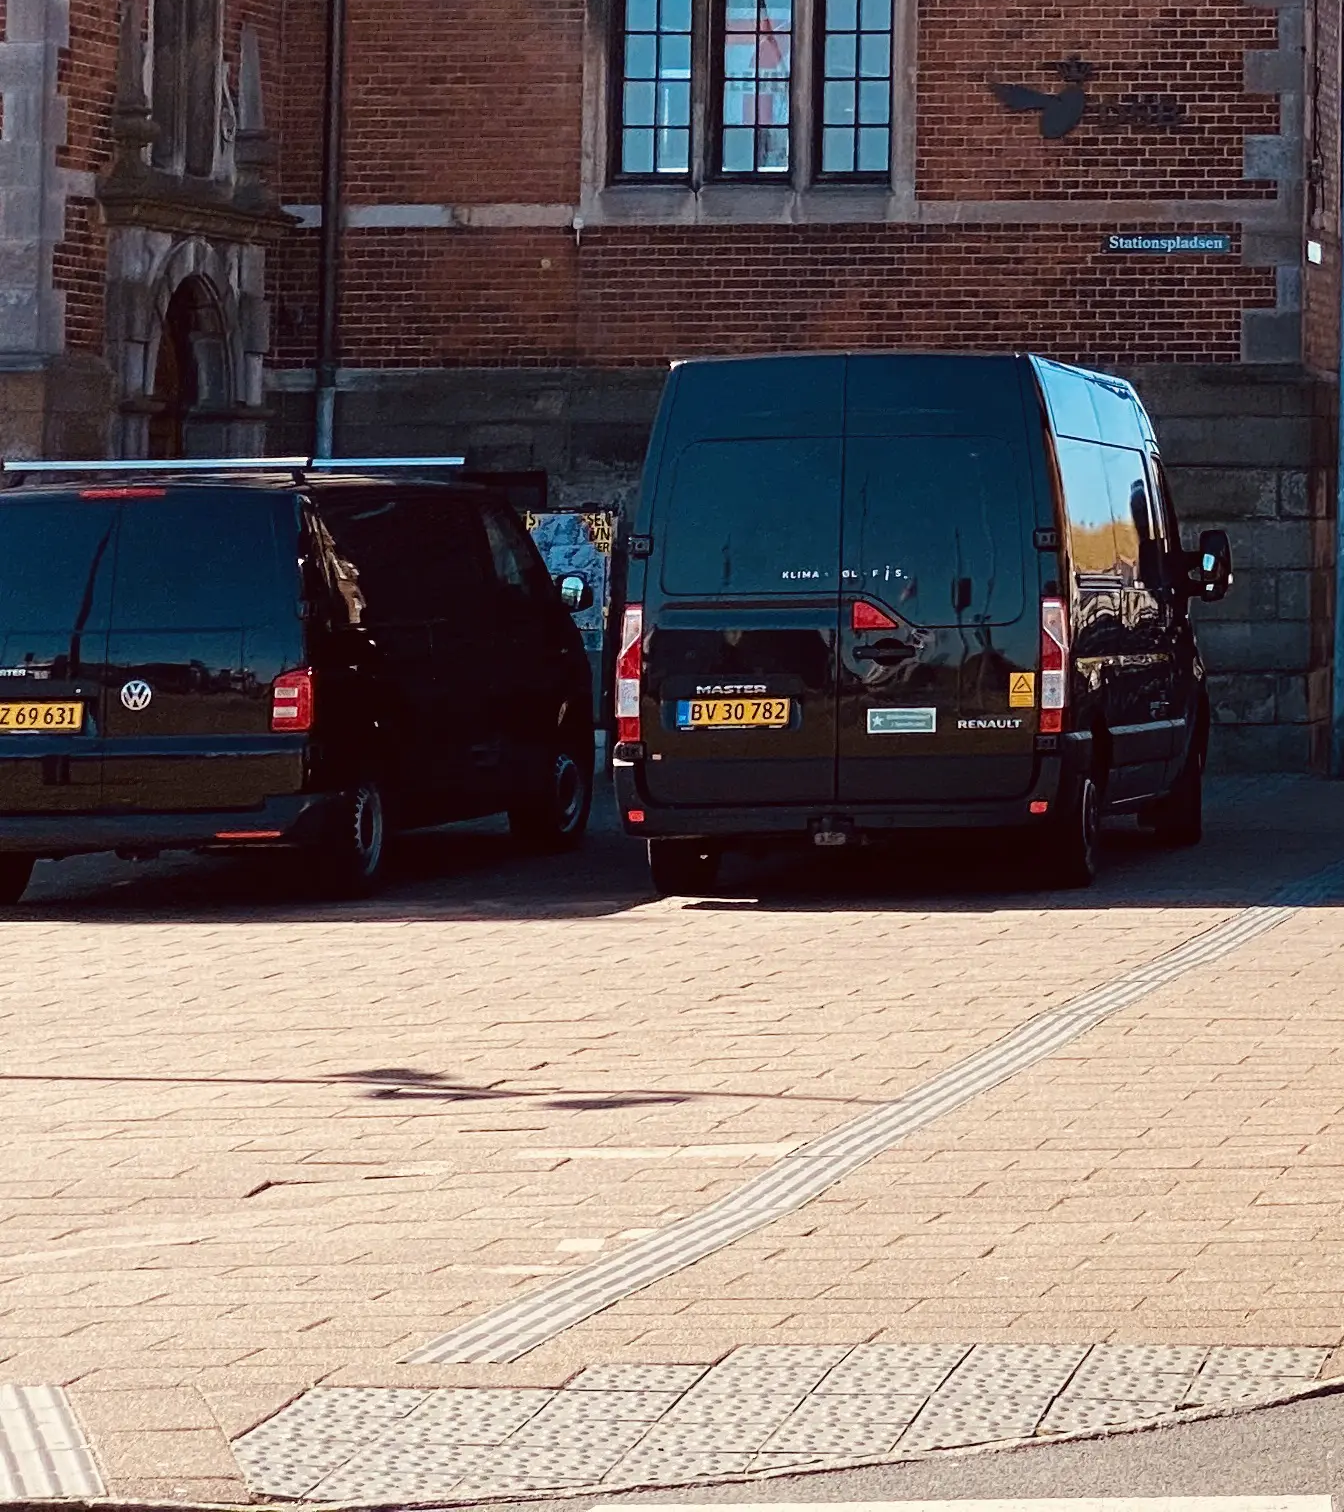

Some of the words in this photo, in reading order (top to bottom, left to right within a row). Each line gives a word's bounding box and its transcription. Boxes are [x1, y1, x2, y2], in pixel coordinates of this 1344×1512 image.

[1108, 235, 1223, 253] Stationspladsen
[782, 571, 820, 579] KLIMA
[696, 684, 767, 694] MASTER
[15, 707, 38, 725] 69
[43, 707, 76, 725] 631
[691, 703, 717, 721] BV
[722, 702, 745, 720] 30
[751, 701, 785, 720] 782
[957, 719, 1023, 729] RENAULT
